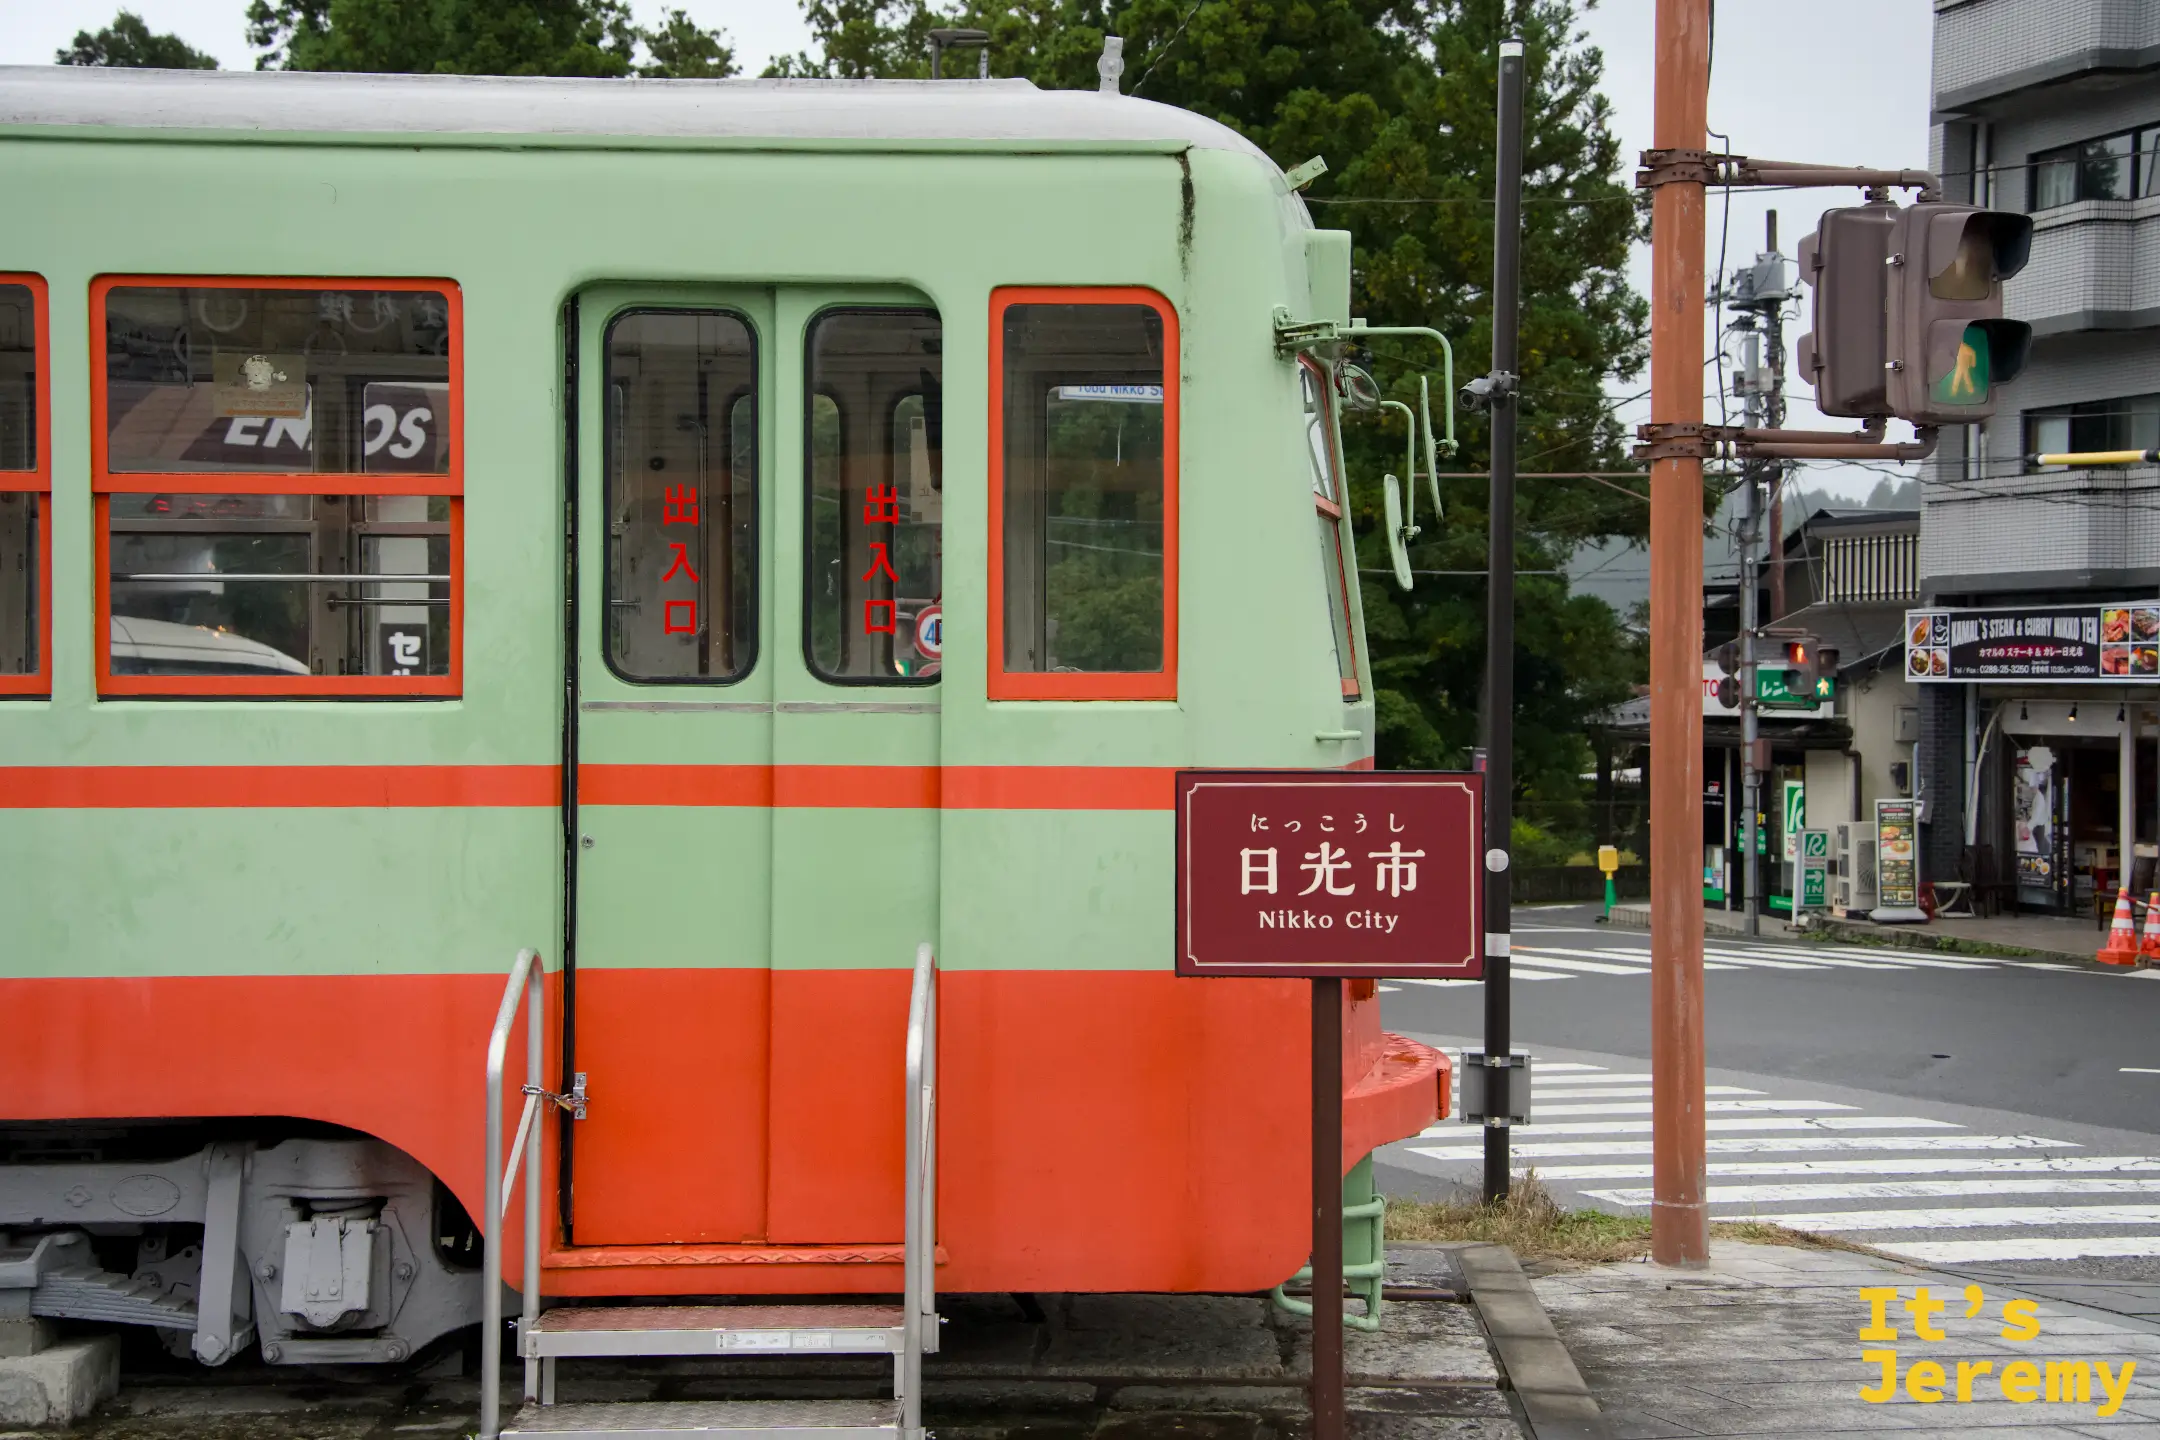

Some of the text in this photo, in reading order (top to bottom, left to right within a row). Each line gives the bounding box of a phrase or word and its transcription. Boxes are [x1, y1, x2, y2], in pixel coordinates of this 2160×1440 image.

[224, 403, 432, 459] ENOS
[662, 483, 700, 635] 出入口
[862, 483, 899, 635] 出入口
[1989, 618, 2015, 639] STEAK
[2016, 619, 2022, 636] &
[2024, 617, 2052, 637] CURRY
[2054, 617, 2080, 640] NIKKO
[2081, 617, 2098, 645] TEN
[1251, 813, 1405, 833] にっこうし
[1240, 841, 1426, 898] 日光市
[1806, 884, 1823, 894] IN
[1259, 910, 1399, 934] Nikko City
